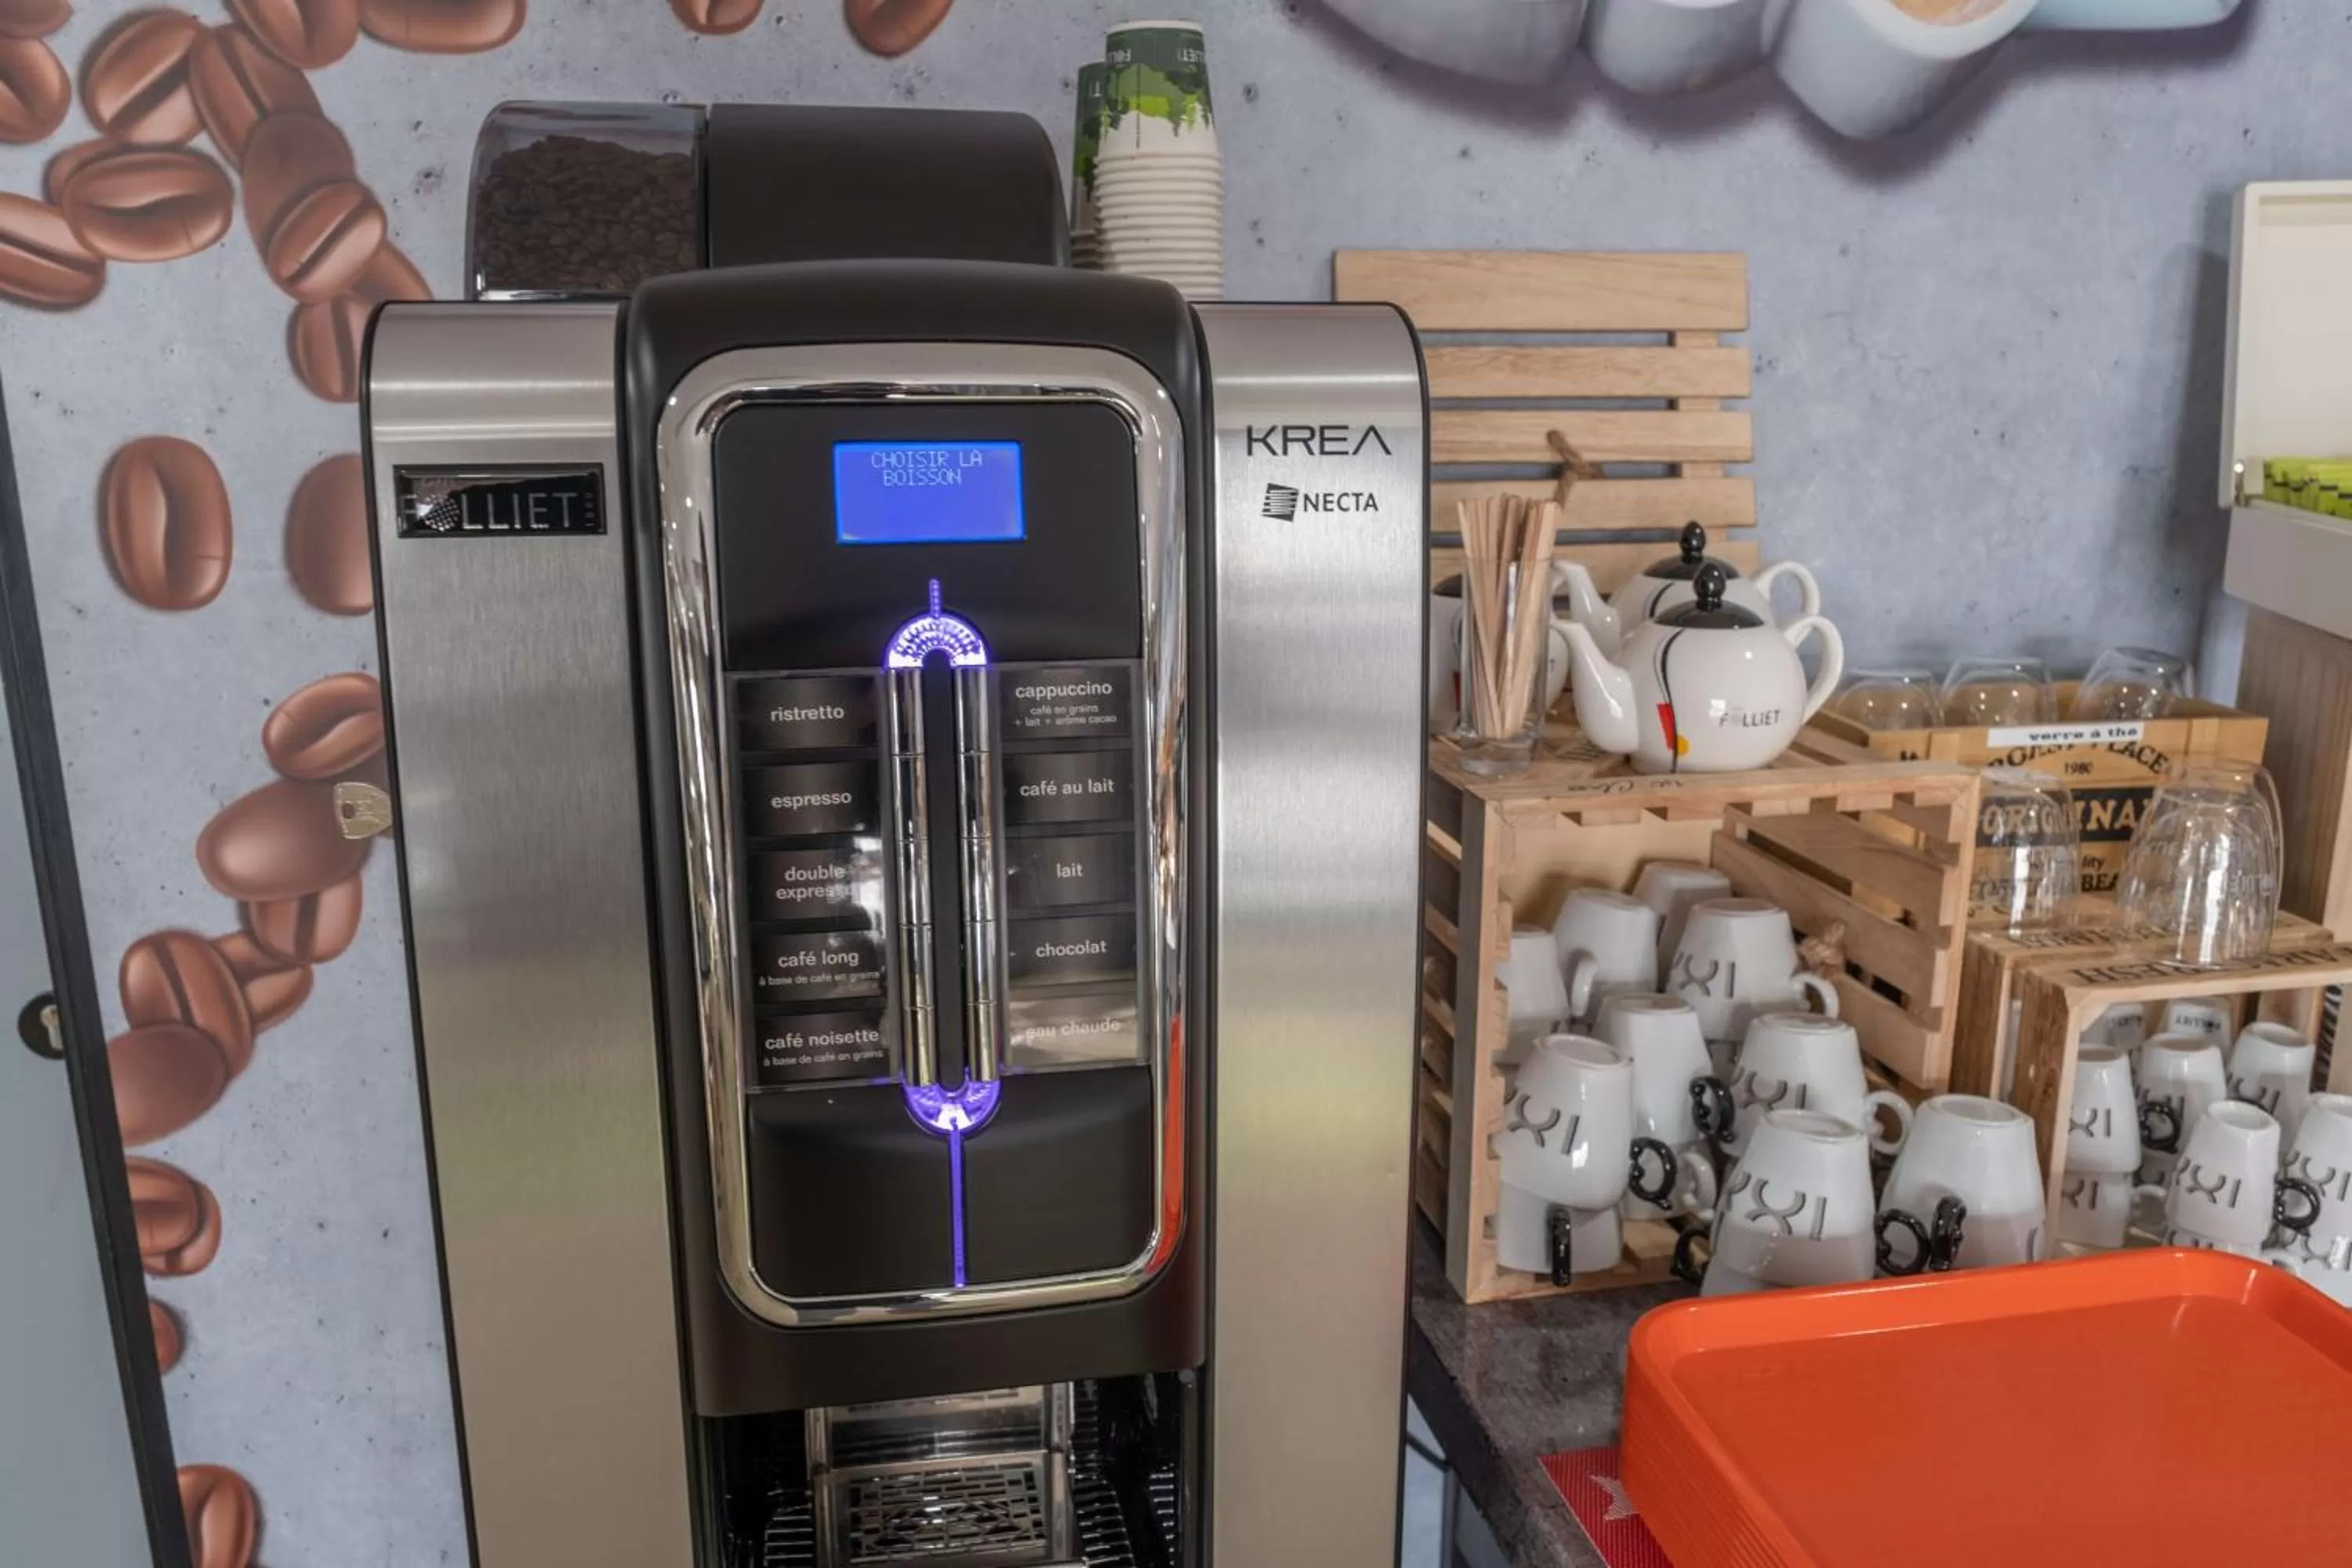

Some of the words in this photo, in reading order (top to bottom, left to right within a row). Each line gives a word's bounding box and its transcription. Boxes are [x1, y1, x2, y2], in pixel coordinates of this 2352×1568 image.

[1247, 424, 1392, 456] KREA
[871, 451, 948, 468] CHOISIR
[959, 449, 982, 467] LA
[884, 469, 961, 487] BOISSON
[1303, 492, 1379, 512] NECTA
[1015, 681, 1112, 701] cappuccino
[771, 706, 844, 722] ristretto
[1020, 779, 1058, 797] café
[1062, 783, 1083, 795] au
[1088, 778, 1115, 793] lait
[771, 792, 852, 811] espresso
[784, 863, 846, 882] double
[1056, 862, 1083, 879] lait
[1036, 939, 1108, 958] chocolat
[778, 949, 816, 968] café
[822, 949, 859, 967] long
[764, 1033, 804, 1051] café
[808, 1028, 879, 1047] noisette
